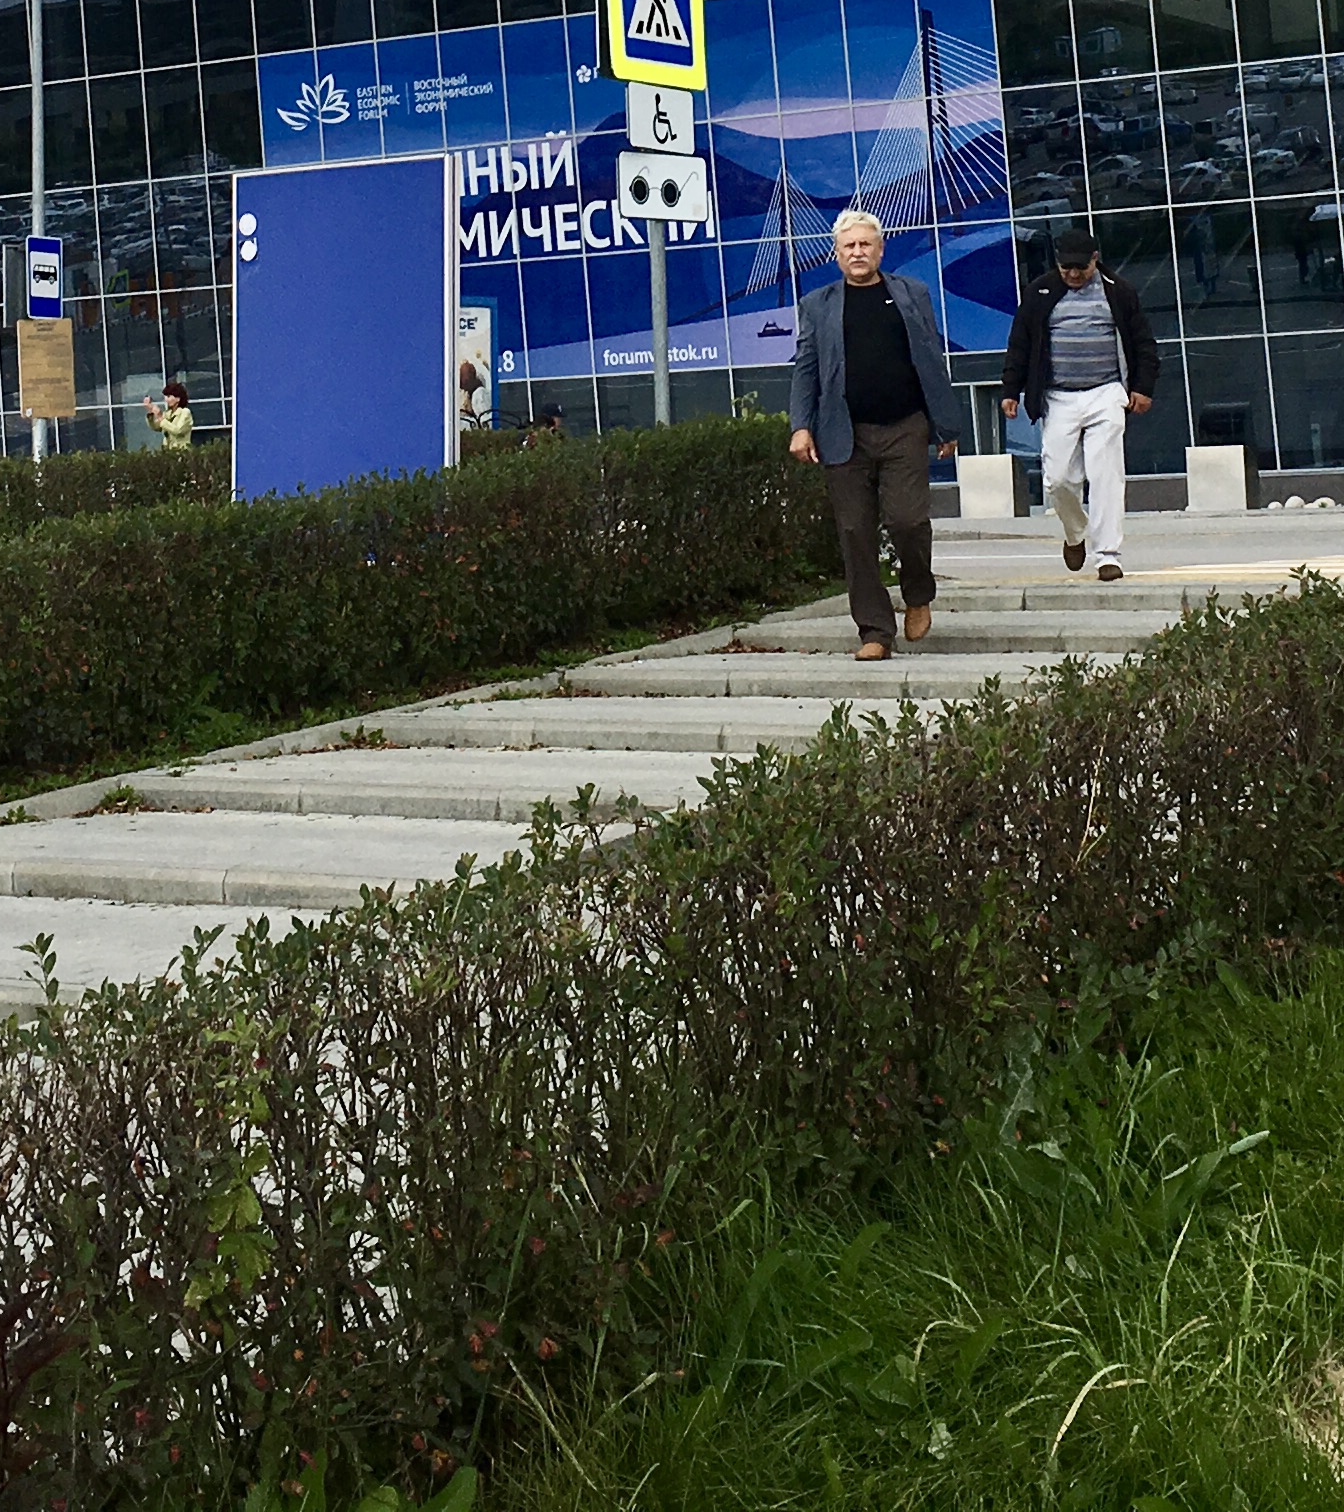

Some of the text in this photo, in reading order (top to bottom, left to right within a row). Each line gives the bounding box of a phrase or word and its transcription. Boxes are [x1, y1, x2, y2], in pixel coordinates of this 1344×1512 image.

[413, 73, 468, 91] ВОСТОЧНЫЙ
[356, 84, 393, 98] EASTRN
[358, 108, 388, 120] FORUM
[415, 100, 447, 114] ФОРУМ
[459, 190, 716, 258] МИЧЕСК
[603, 344, 718, 366] forumvstok.ru
